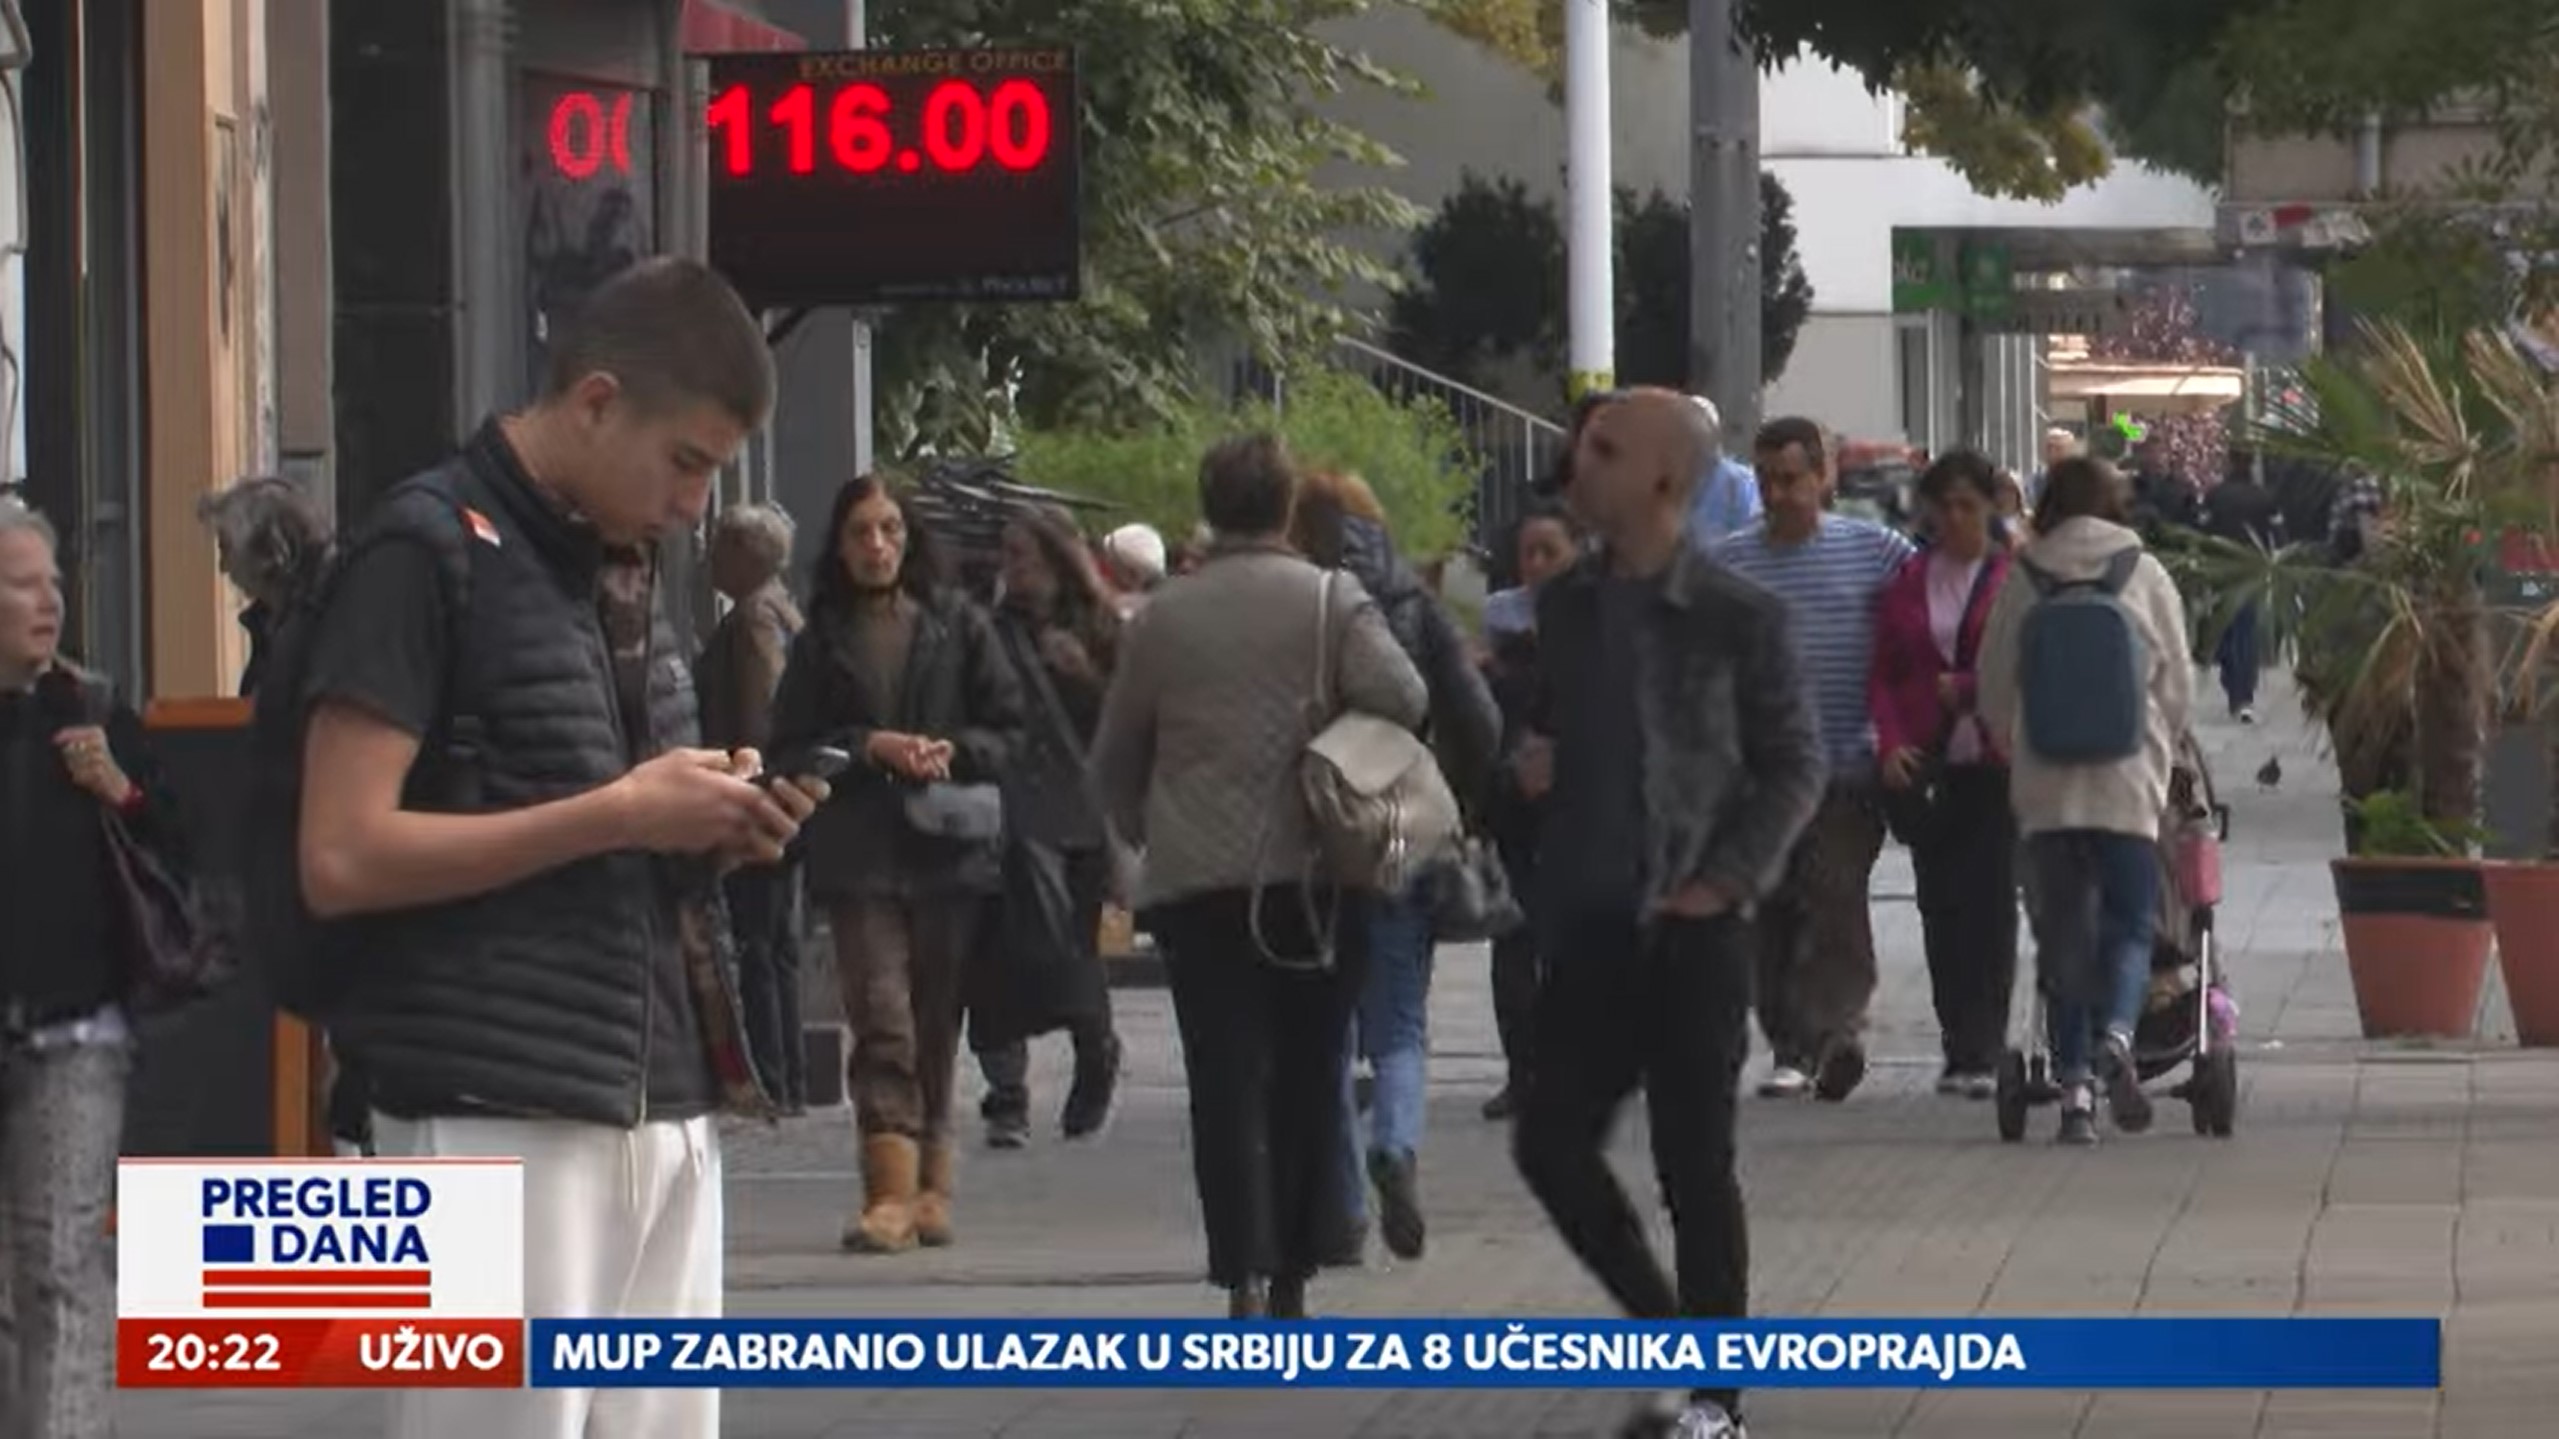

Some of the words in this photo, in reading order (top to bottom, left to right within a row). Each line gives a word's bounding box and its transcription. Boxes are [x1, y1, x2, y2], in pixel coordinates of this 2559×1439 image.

[800, 52, 961, 79] EXCHANGE
[969, 51, 1067, 73] OFFICE
[706, 79, 1051, 177] 116.00
